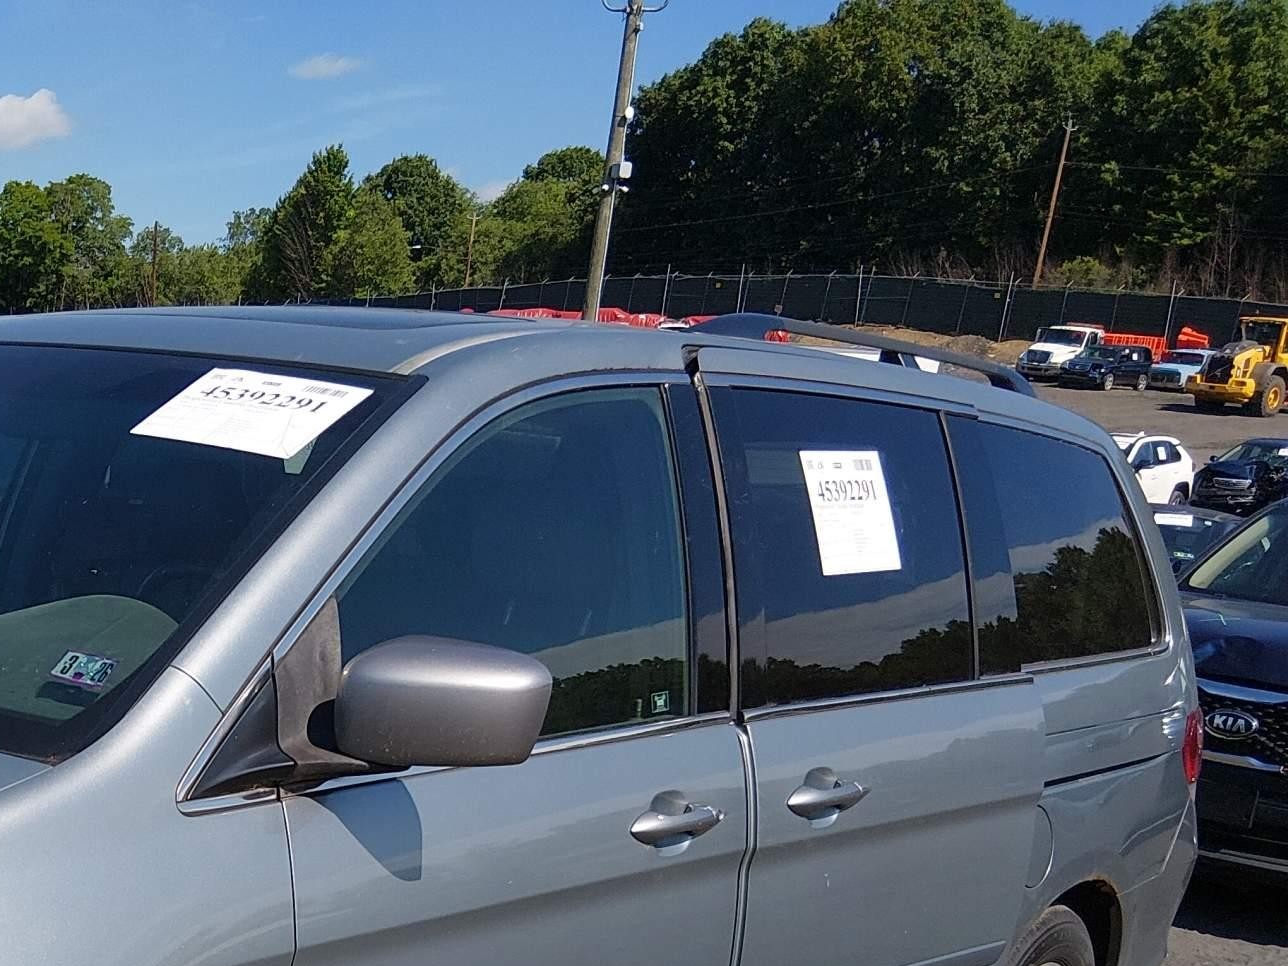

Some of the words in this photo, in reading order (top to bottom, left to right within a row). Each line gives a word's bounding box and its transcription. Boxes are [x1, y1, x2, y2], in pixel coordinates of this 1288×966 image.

[200, 385, 328, 413] 45392291
[818, 479, 877, 502] 45392291
[60, 655, 79, 675] 3
[91, 662, 114, 682] 26
[1213, 714, 1246, 734] KIA
